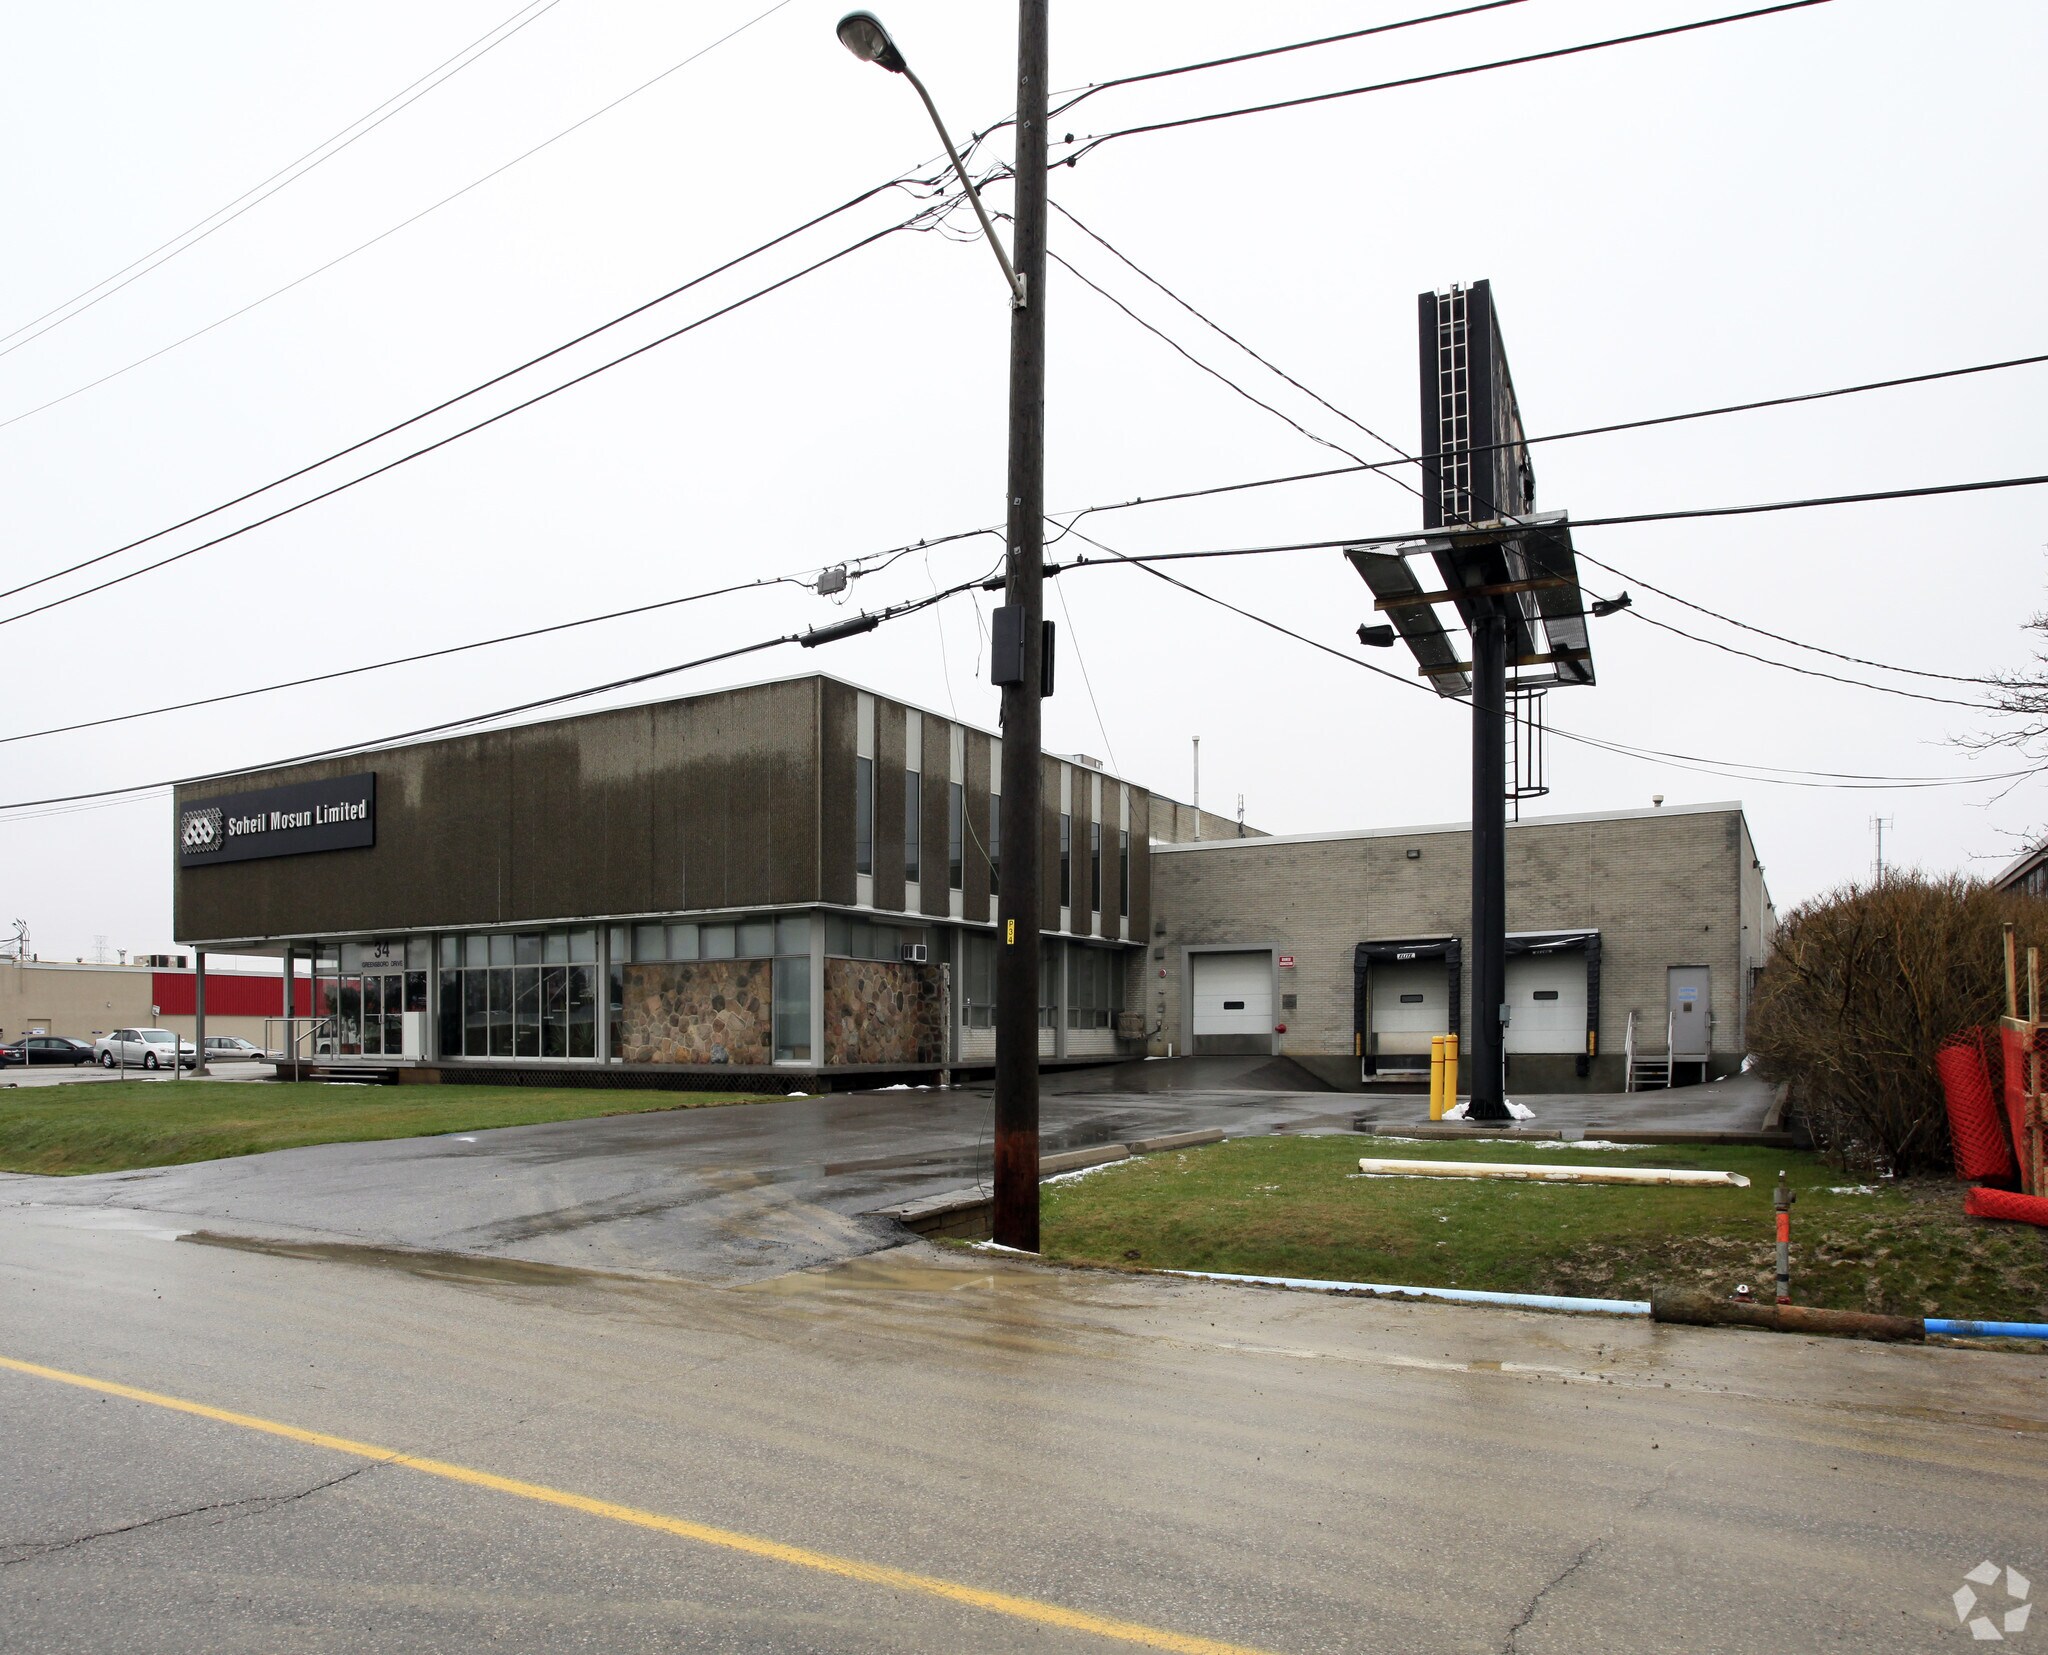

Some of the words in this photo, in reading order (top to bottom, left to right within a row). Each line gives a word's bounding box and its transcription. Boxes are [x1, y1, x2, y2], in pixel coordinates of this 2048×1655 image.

[228, 814, 266, 836] Soheil
[270, 811, 312, 830] Mosun
[316, 799, 367, 824] Limited
[374, 941, 390, 958] 34
